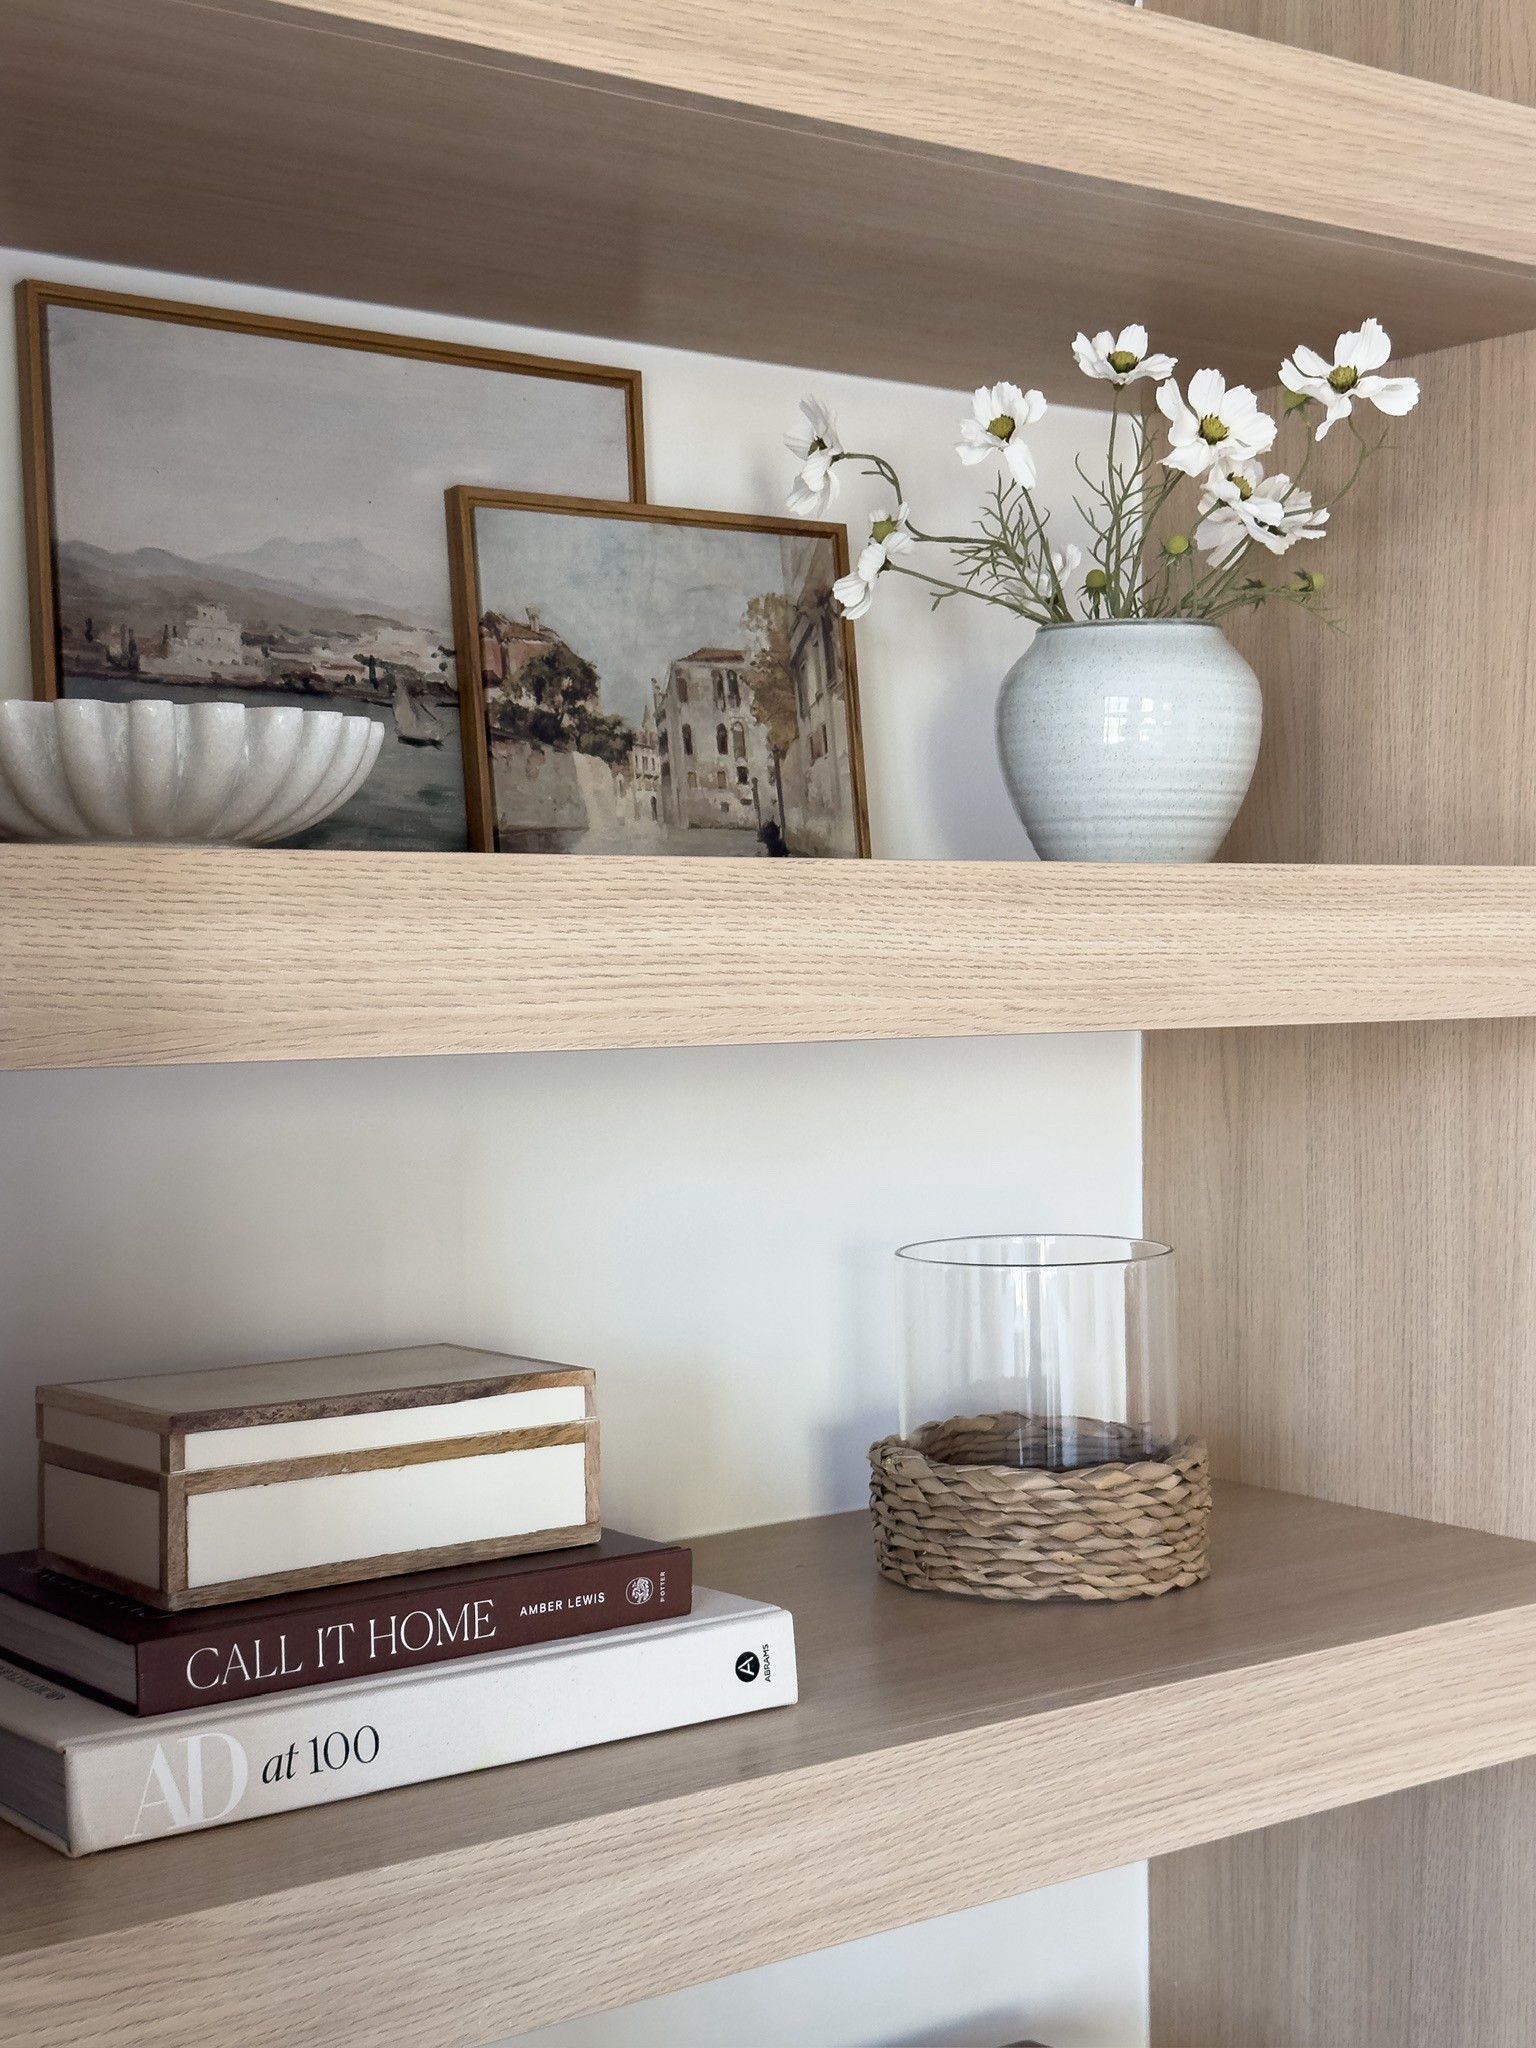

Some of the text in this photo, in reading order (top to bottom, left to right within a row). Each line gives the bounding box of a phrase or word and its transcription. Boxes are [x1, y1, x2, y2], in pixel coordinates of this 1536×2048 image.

[519, 1591, 605, 1617] AMBER LEWIS
[186, 1599, 497, 1690] CALL IT HOME
[762, 1643, 771, 1683] ABRAMS
[737, 1656, 755, 1676] A
[124, 1725, 380, 1840] AD at 100
